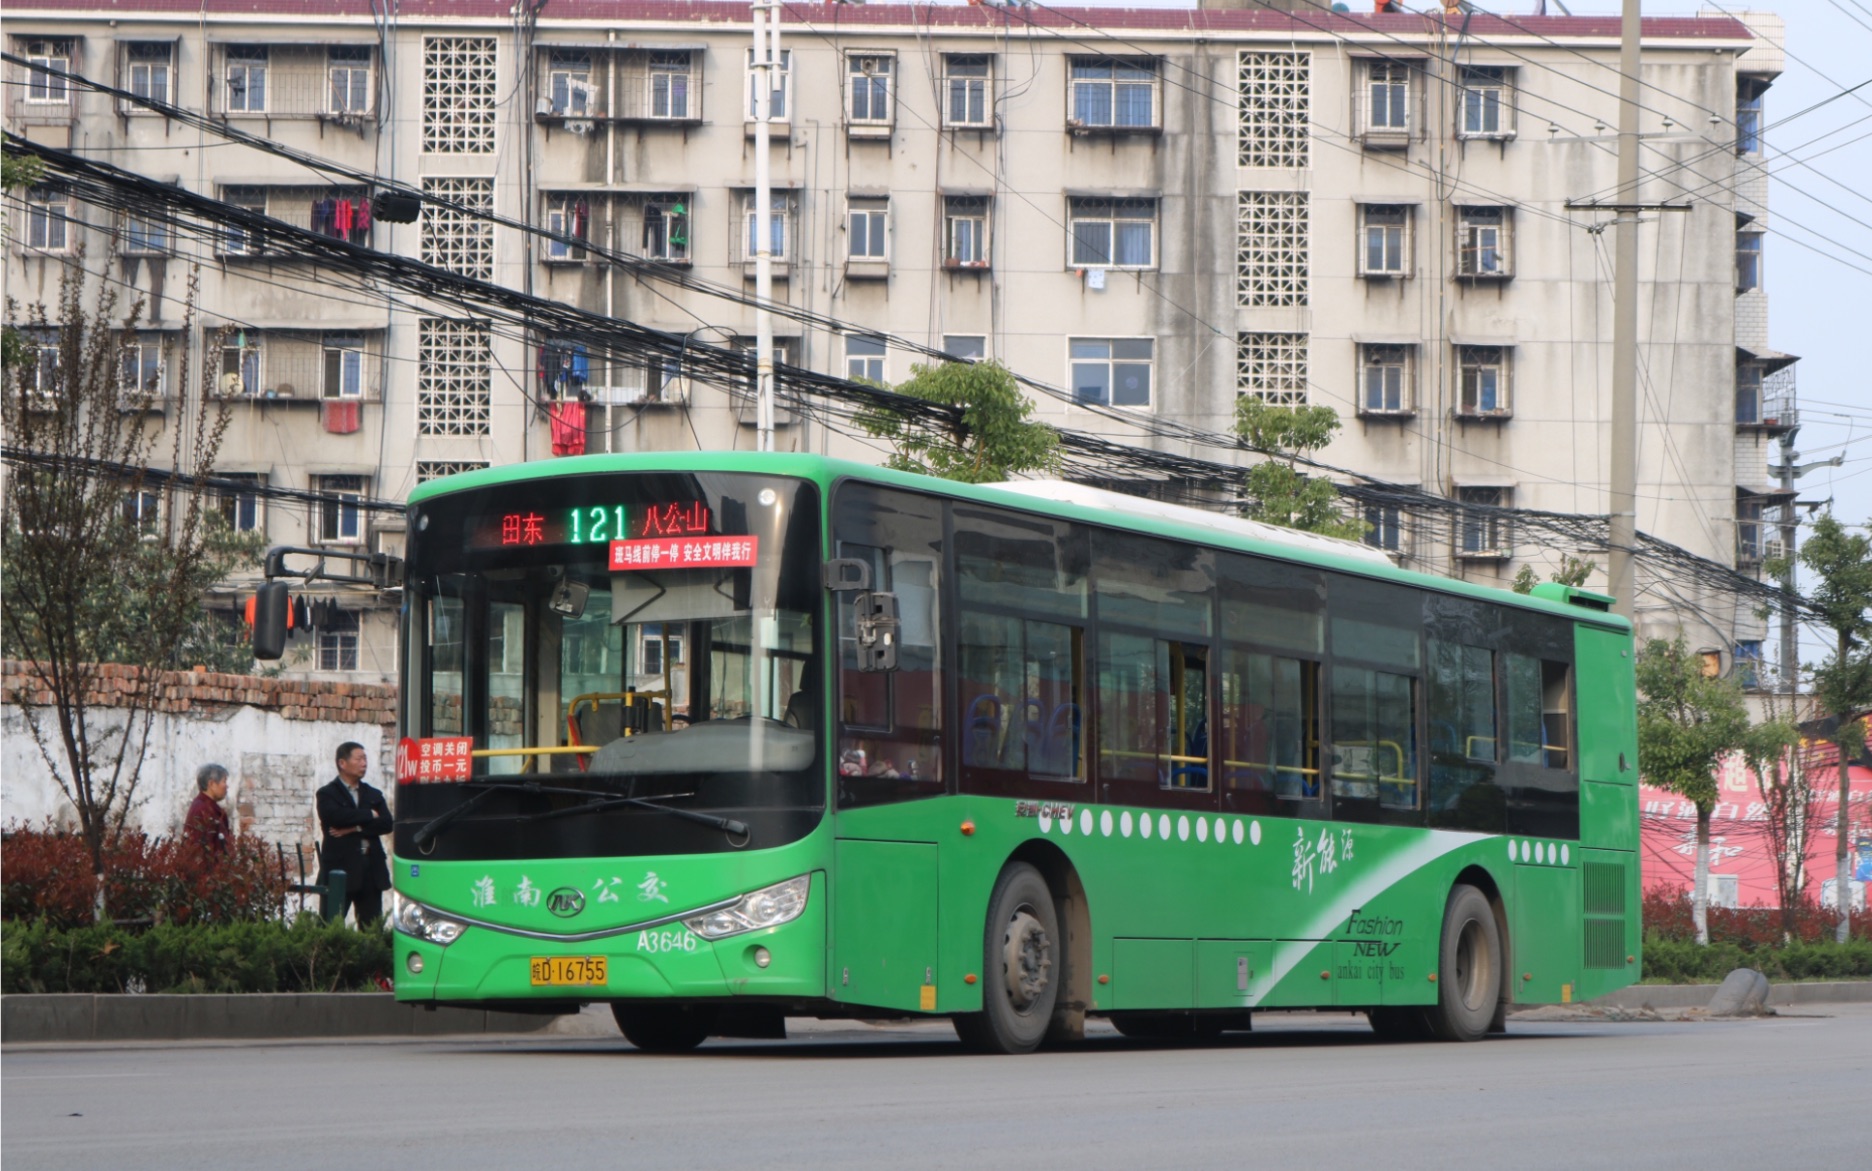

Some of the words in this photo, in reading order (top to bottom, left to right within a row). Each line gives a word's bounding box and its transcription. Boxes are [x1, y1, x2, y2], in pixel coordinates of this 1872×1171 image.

[502, 512, 544, 545] 田东
[570, 505, 626, 543] 121
[642, 500, 708, 536] 八公山
[614, 543, 679, 564] 斑马线前停一停
[683, 541, 752, 561] 安全文明伴我行
[421, 742, 467, 757] 空调关闭
[420, 758, 467, 774] 投币一元
[1346, 909, 1403, 935] Fashion
[636, 930, 697, 953] A3646
[1353, 942, 1401, 957] NEW
[1367, 960, 1385, 985] city
[1389, 960, 1405, 980] bus
